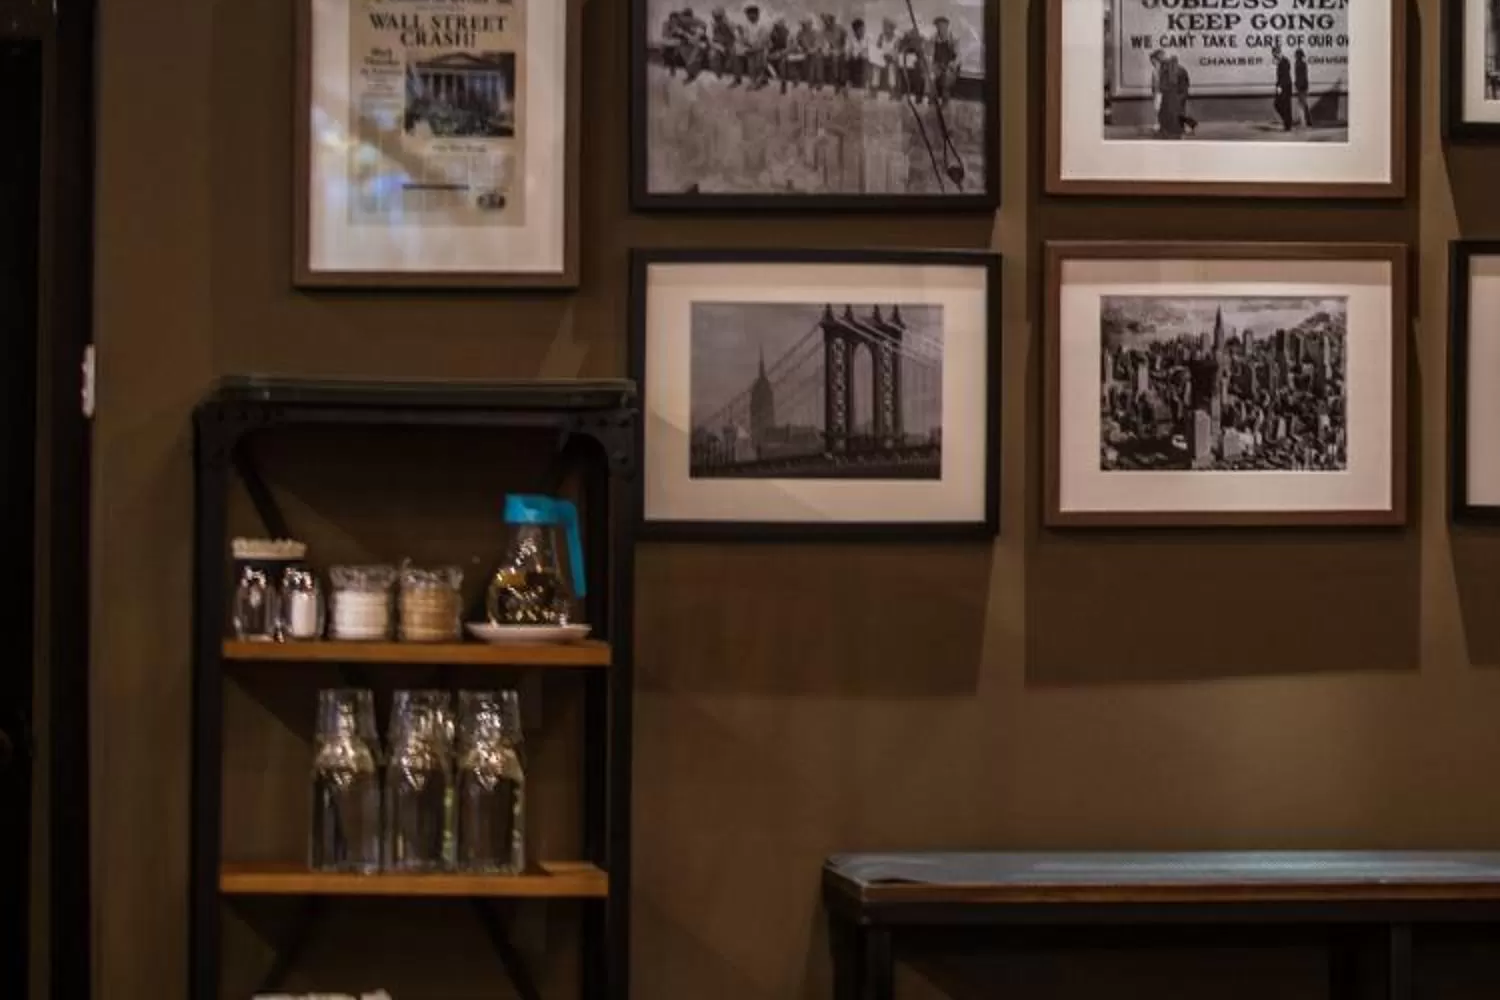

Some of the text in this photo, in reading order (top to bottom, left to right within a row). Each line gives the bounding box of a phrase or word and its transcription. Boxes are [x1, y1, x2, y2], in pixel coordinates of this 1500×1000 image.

[369, 12, 508, 32] WALL STREET
[1167, 13, 1334, 30] KEEP GOING
[1131, 35, 1152, 49] WE
[1202, 35, 1237, 48] TAKE
[1245, 34, 1280, 48] CARE
[1286, 35, 1304, 48] OF
[1307, 35, 1332, 48] OUR
